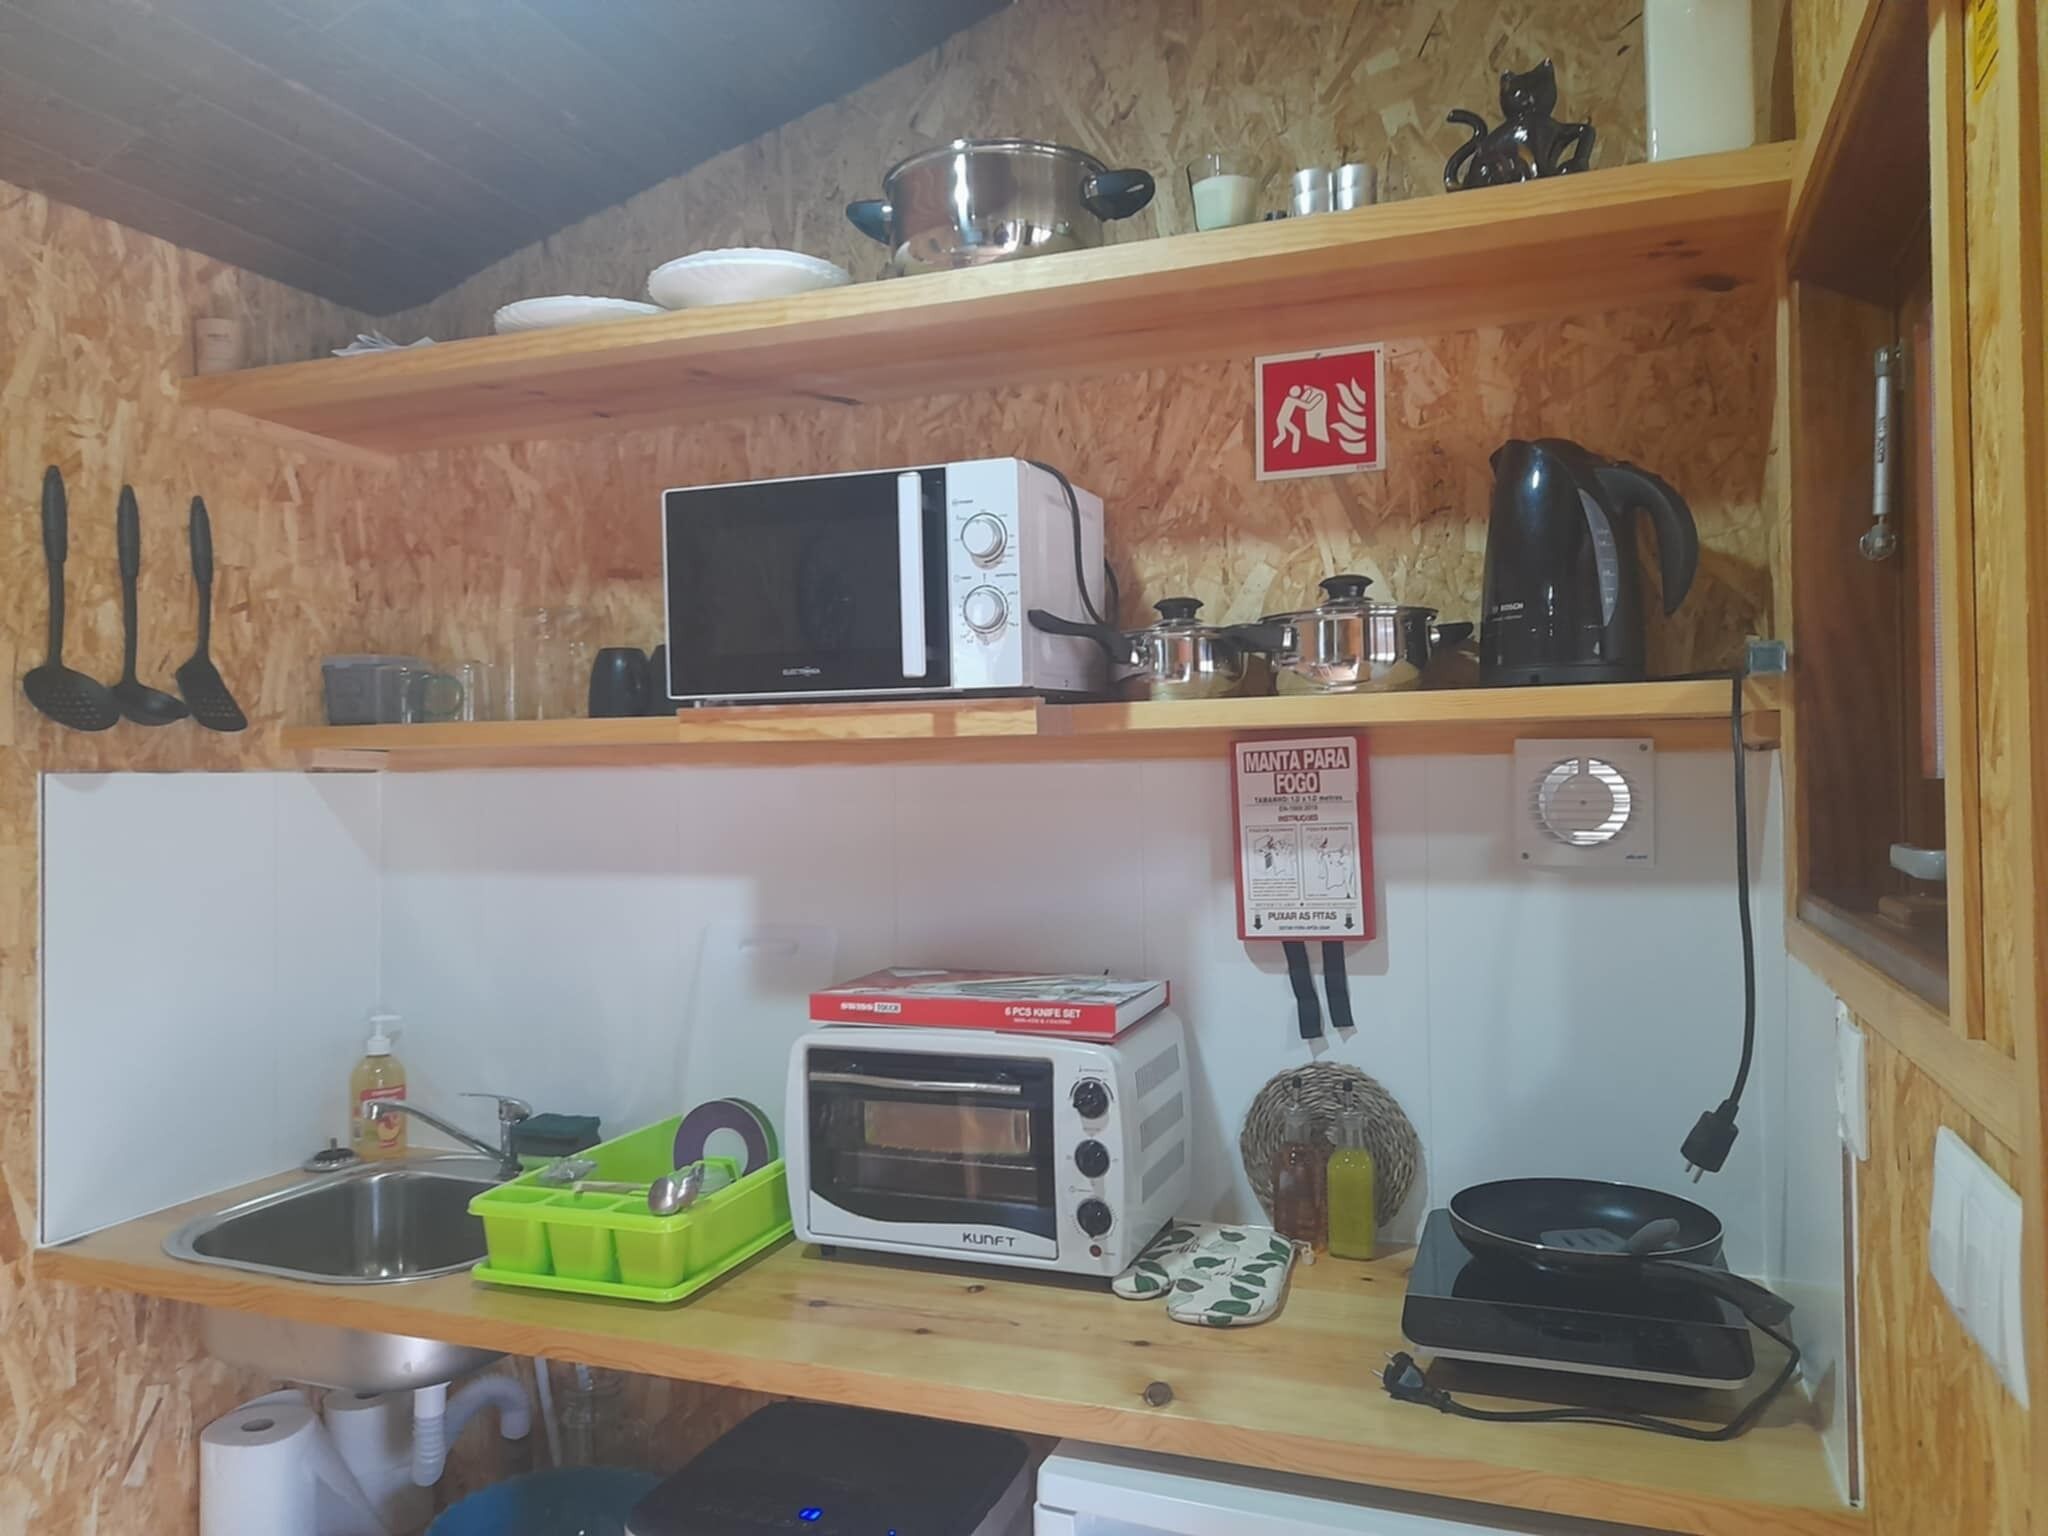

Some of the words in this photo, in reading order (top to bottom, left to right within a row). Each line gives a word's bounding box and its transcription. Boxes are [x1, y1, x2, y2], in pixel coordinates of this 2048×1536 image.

[1245, 750, 1300, 772] MANTA
[1303, 747, 1348, 769] PARA
[1276, 772, 1318, 793] FOGO
[1268, 911, 1297, 920] PUXAR
[1299, 911, 1311, 920] AS
[1312, 911, 1337, 920] FITAS
[1012, 1006, 1032, 1017] PCS
[1033, 1007, 1061, 1018] KNIFE
[1063, 1008, 1081, 1018] SET
